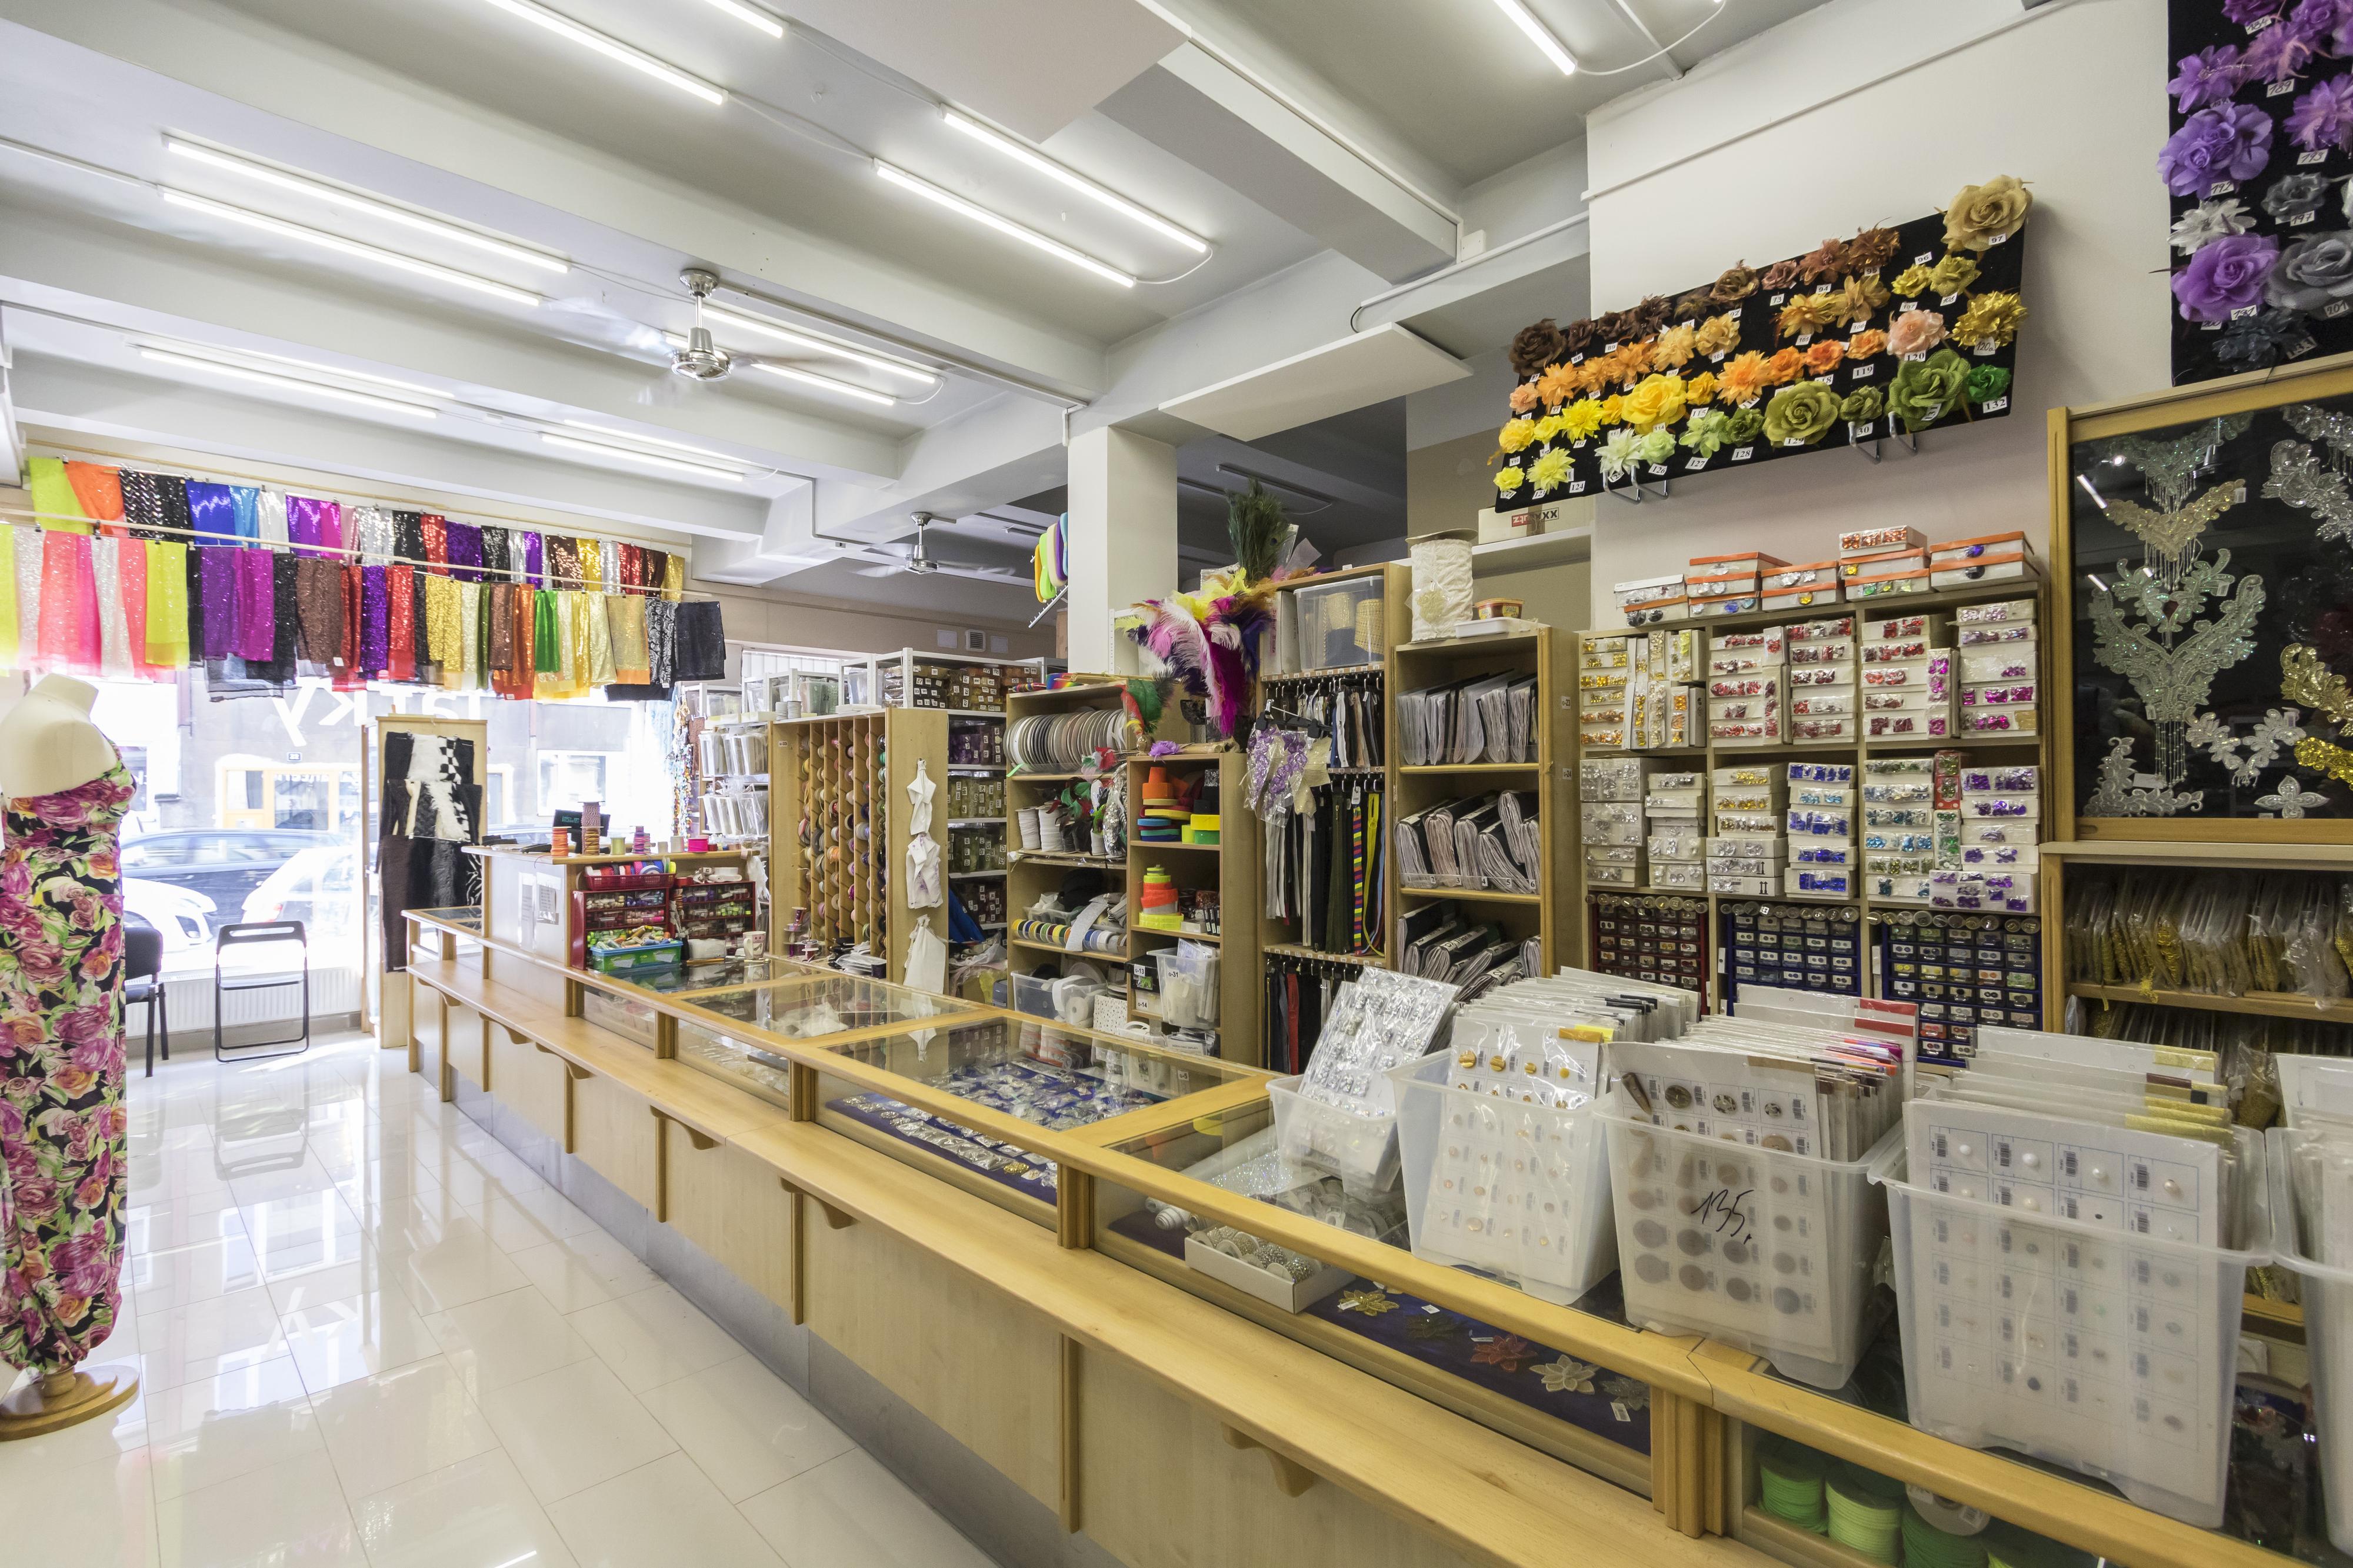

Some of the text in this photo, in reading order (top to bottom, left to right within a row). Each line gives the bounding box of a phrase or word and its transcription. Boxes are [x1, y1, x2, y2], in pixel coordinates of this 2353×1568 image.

[2269, 81, 2292, 94] 189
[2301, 152, 2323, 164] 193
[2211, 182, 2230, 194] 192
[2291, 212, 2312, 223] 197
[2327, 303, 2346, 315] 201
[1907, 352, 1924, 361] 120
[1856, 366, 1873, 376] 119
[1985, 399, 2006, 410] 132
[1735, 449, 1751, 458] 128
[1691, 459, 1705, 468] 127
[1652, 465, 1665, 474] 126
[1571, 482, 1584, 491] 124
